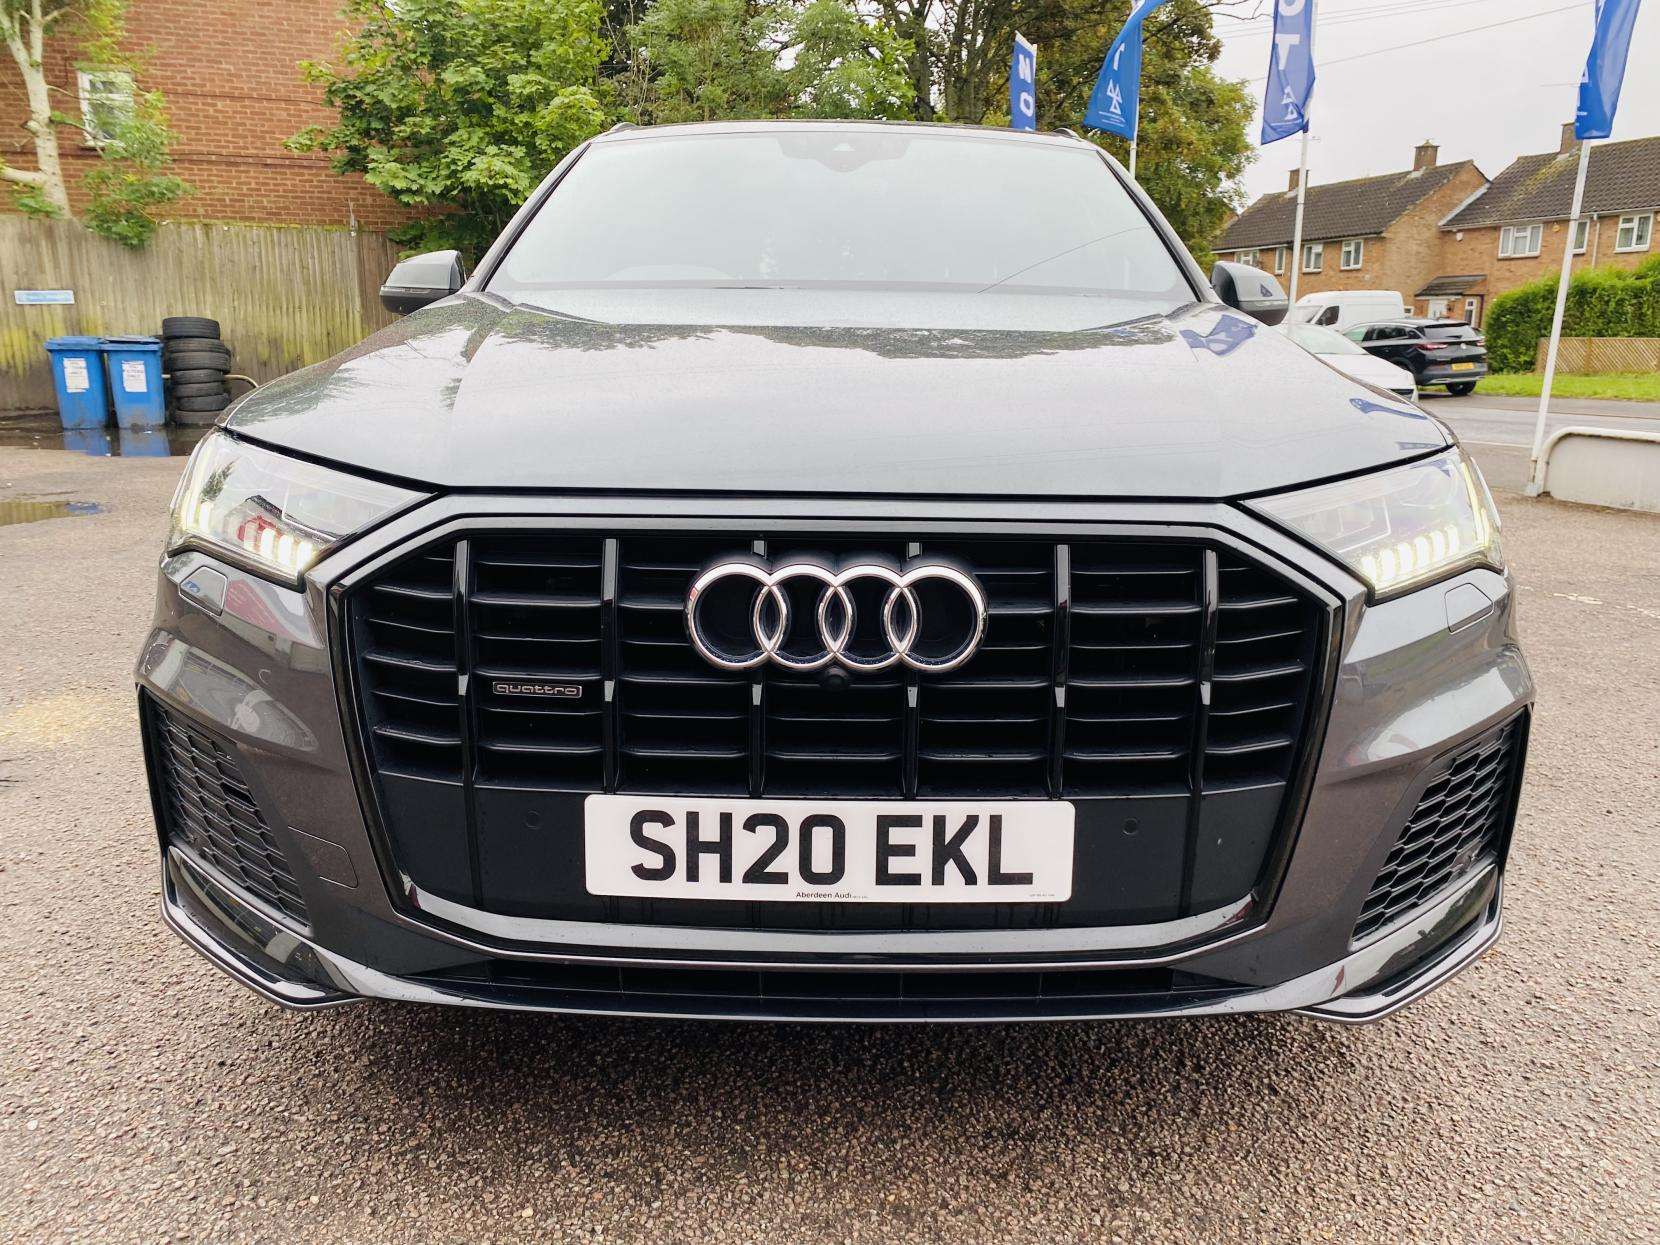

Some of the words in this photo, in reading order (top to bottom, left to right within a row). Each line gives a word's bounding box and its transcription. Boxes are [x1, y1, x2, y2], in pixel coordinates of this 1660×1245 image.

[496, 684, 577, 695] quattro
[629, 809, 846, 886] SH20
[875, 814, 1034, 887] EKL
[796, 891, 832, 899] Aberdeen
[834, 891, 852, 899] Audi
